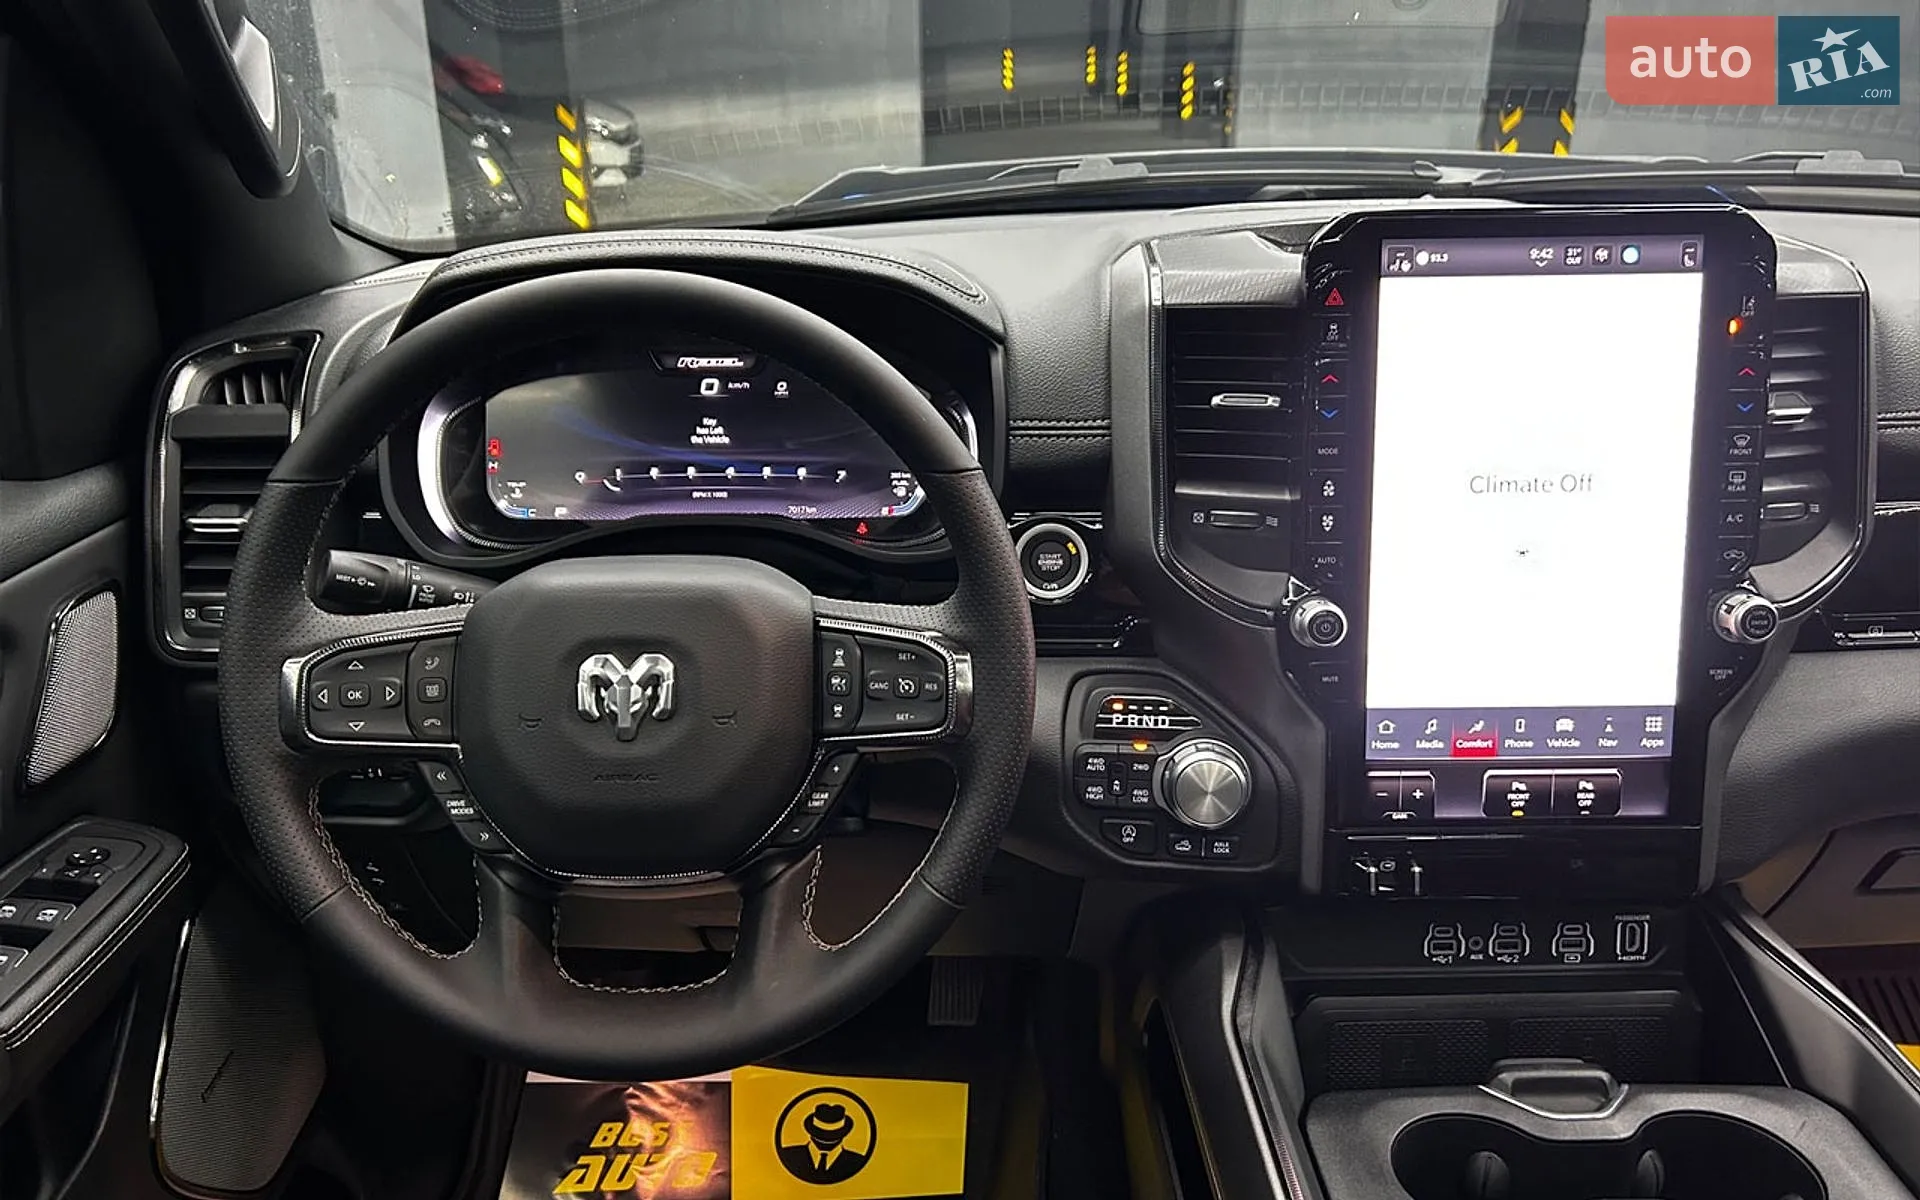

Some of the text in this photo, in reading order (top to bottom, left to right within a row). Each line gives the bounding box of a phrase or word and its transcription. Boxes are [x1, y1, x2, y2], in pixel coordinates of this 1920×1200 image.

[1530, 248, 1554, 260] 9:42
[701, 378, 720, 396] 0
[702, 416, 717, 427] Key
[690, 435, 730, 444] the Vehicle
[1469, 473, 1593, 494] Climate Off
[1727, 514, 1744, 523] A/C
[1322, 675, 1339, 683] MUTE
[869, 682, 889, 690] CANC
[925, 682, 938, 690] RES
[347, 690, 363, 701] OK
[1371, 739, 1400, 749] Home
[1416, 739, 1444, 749] Media
[1456, 739, 1493, 749] Comfort
[1504, 739, 1534, 749] Phone
[1547, 738, 1580, 748] Vehicle
[1598, 738, 1618, 748] Nav
[1640, 737, 1664, 749] Apps
[811, 792, 829, 800] GEAR
[1507, 793, 1531, 801] FRONT
[446, 799, 465, 807] DRIVE
[808, 800, 825, 808] LIMIT
[1510, 800, 1525, 808] OFF
[1578, 799, 1592, 807] OFF
[450, 807, 474, 815] MODES
